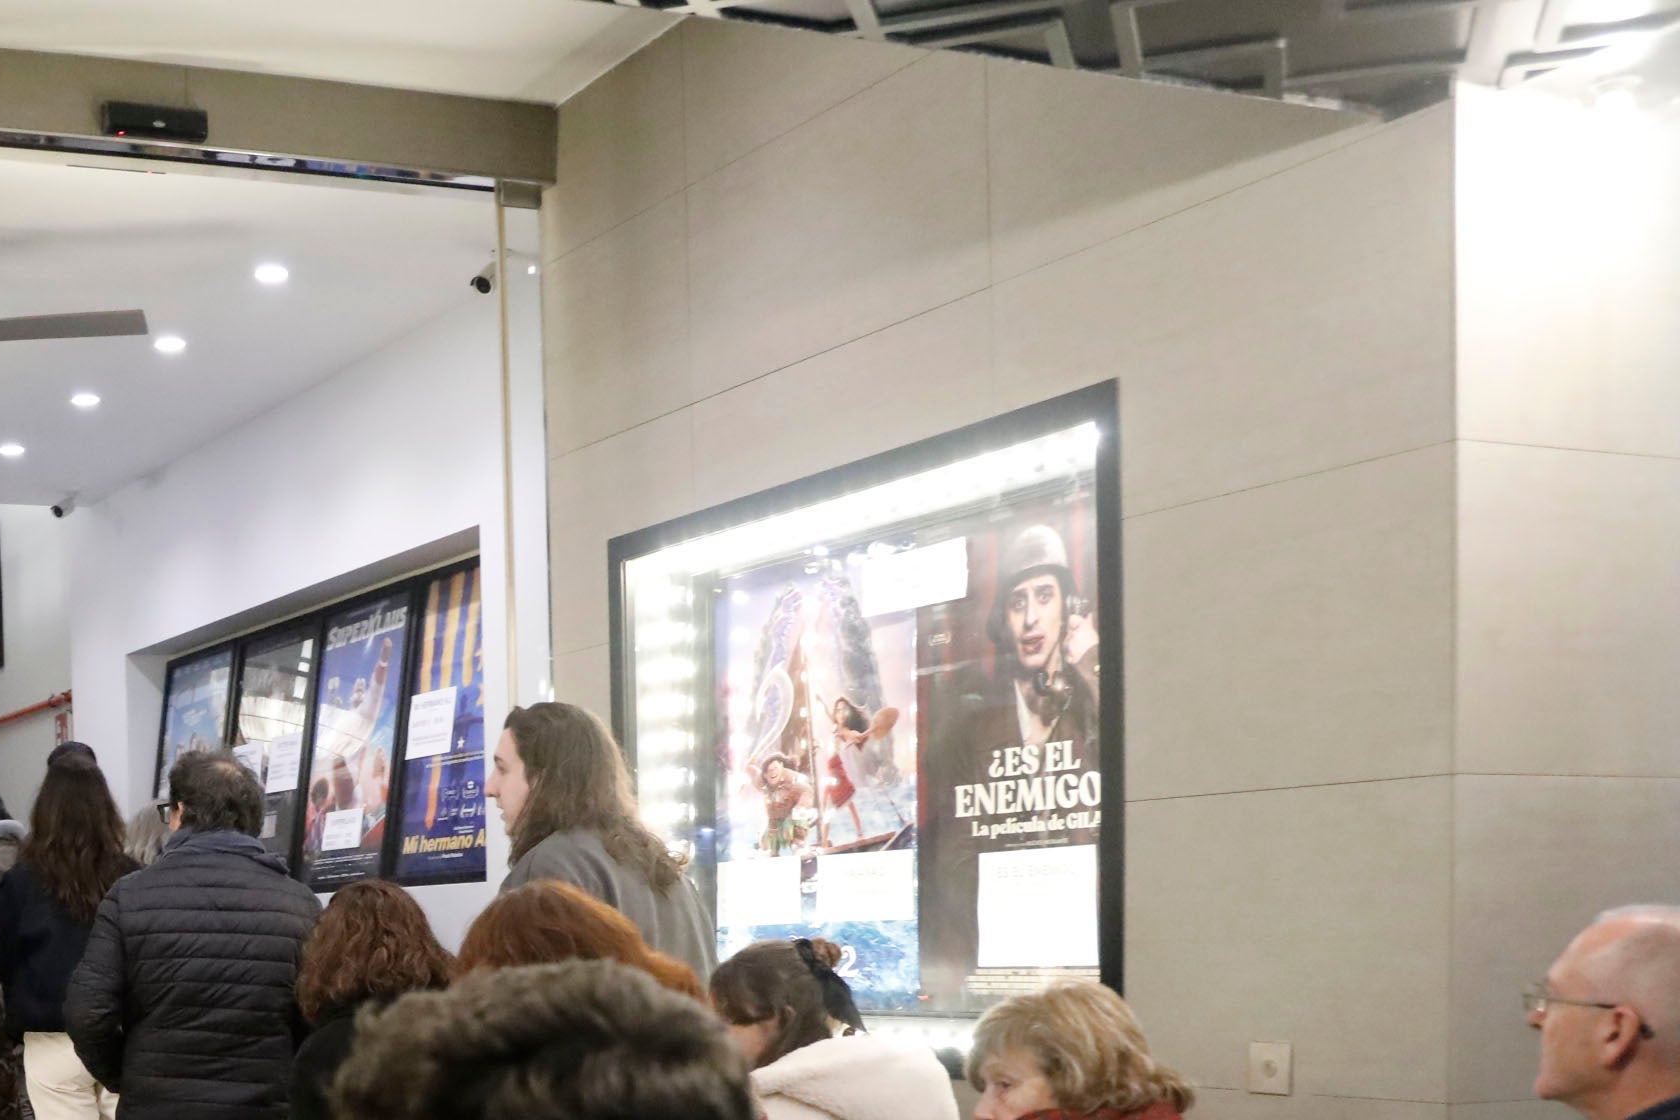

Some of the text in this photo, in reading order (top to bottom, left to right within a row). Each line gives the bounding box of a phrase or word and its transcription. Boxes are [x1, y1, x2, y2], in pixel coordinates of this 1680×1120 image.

[988, 740, 1082, 778] ¿ES EL
[971, 821, 990, 837] La
[990, 816, 1046, 840] película
[1047, 813, 1066, 831] de
[402, 834, 419, 855] Mi
[419, 834, 474, 853] hermano
[837, 945, 860, 978] 2
